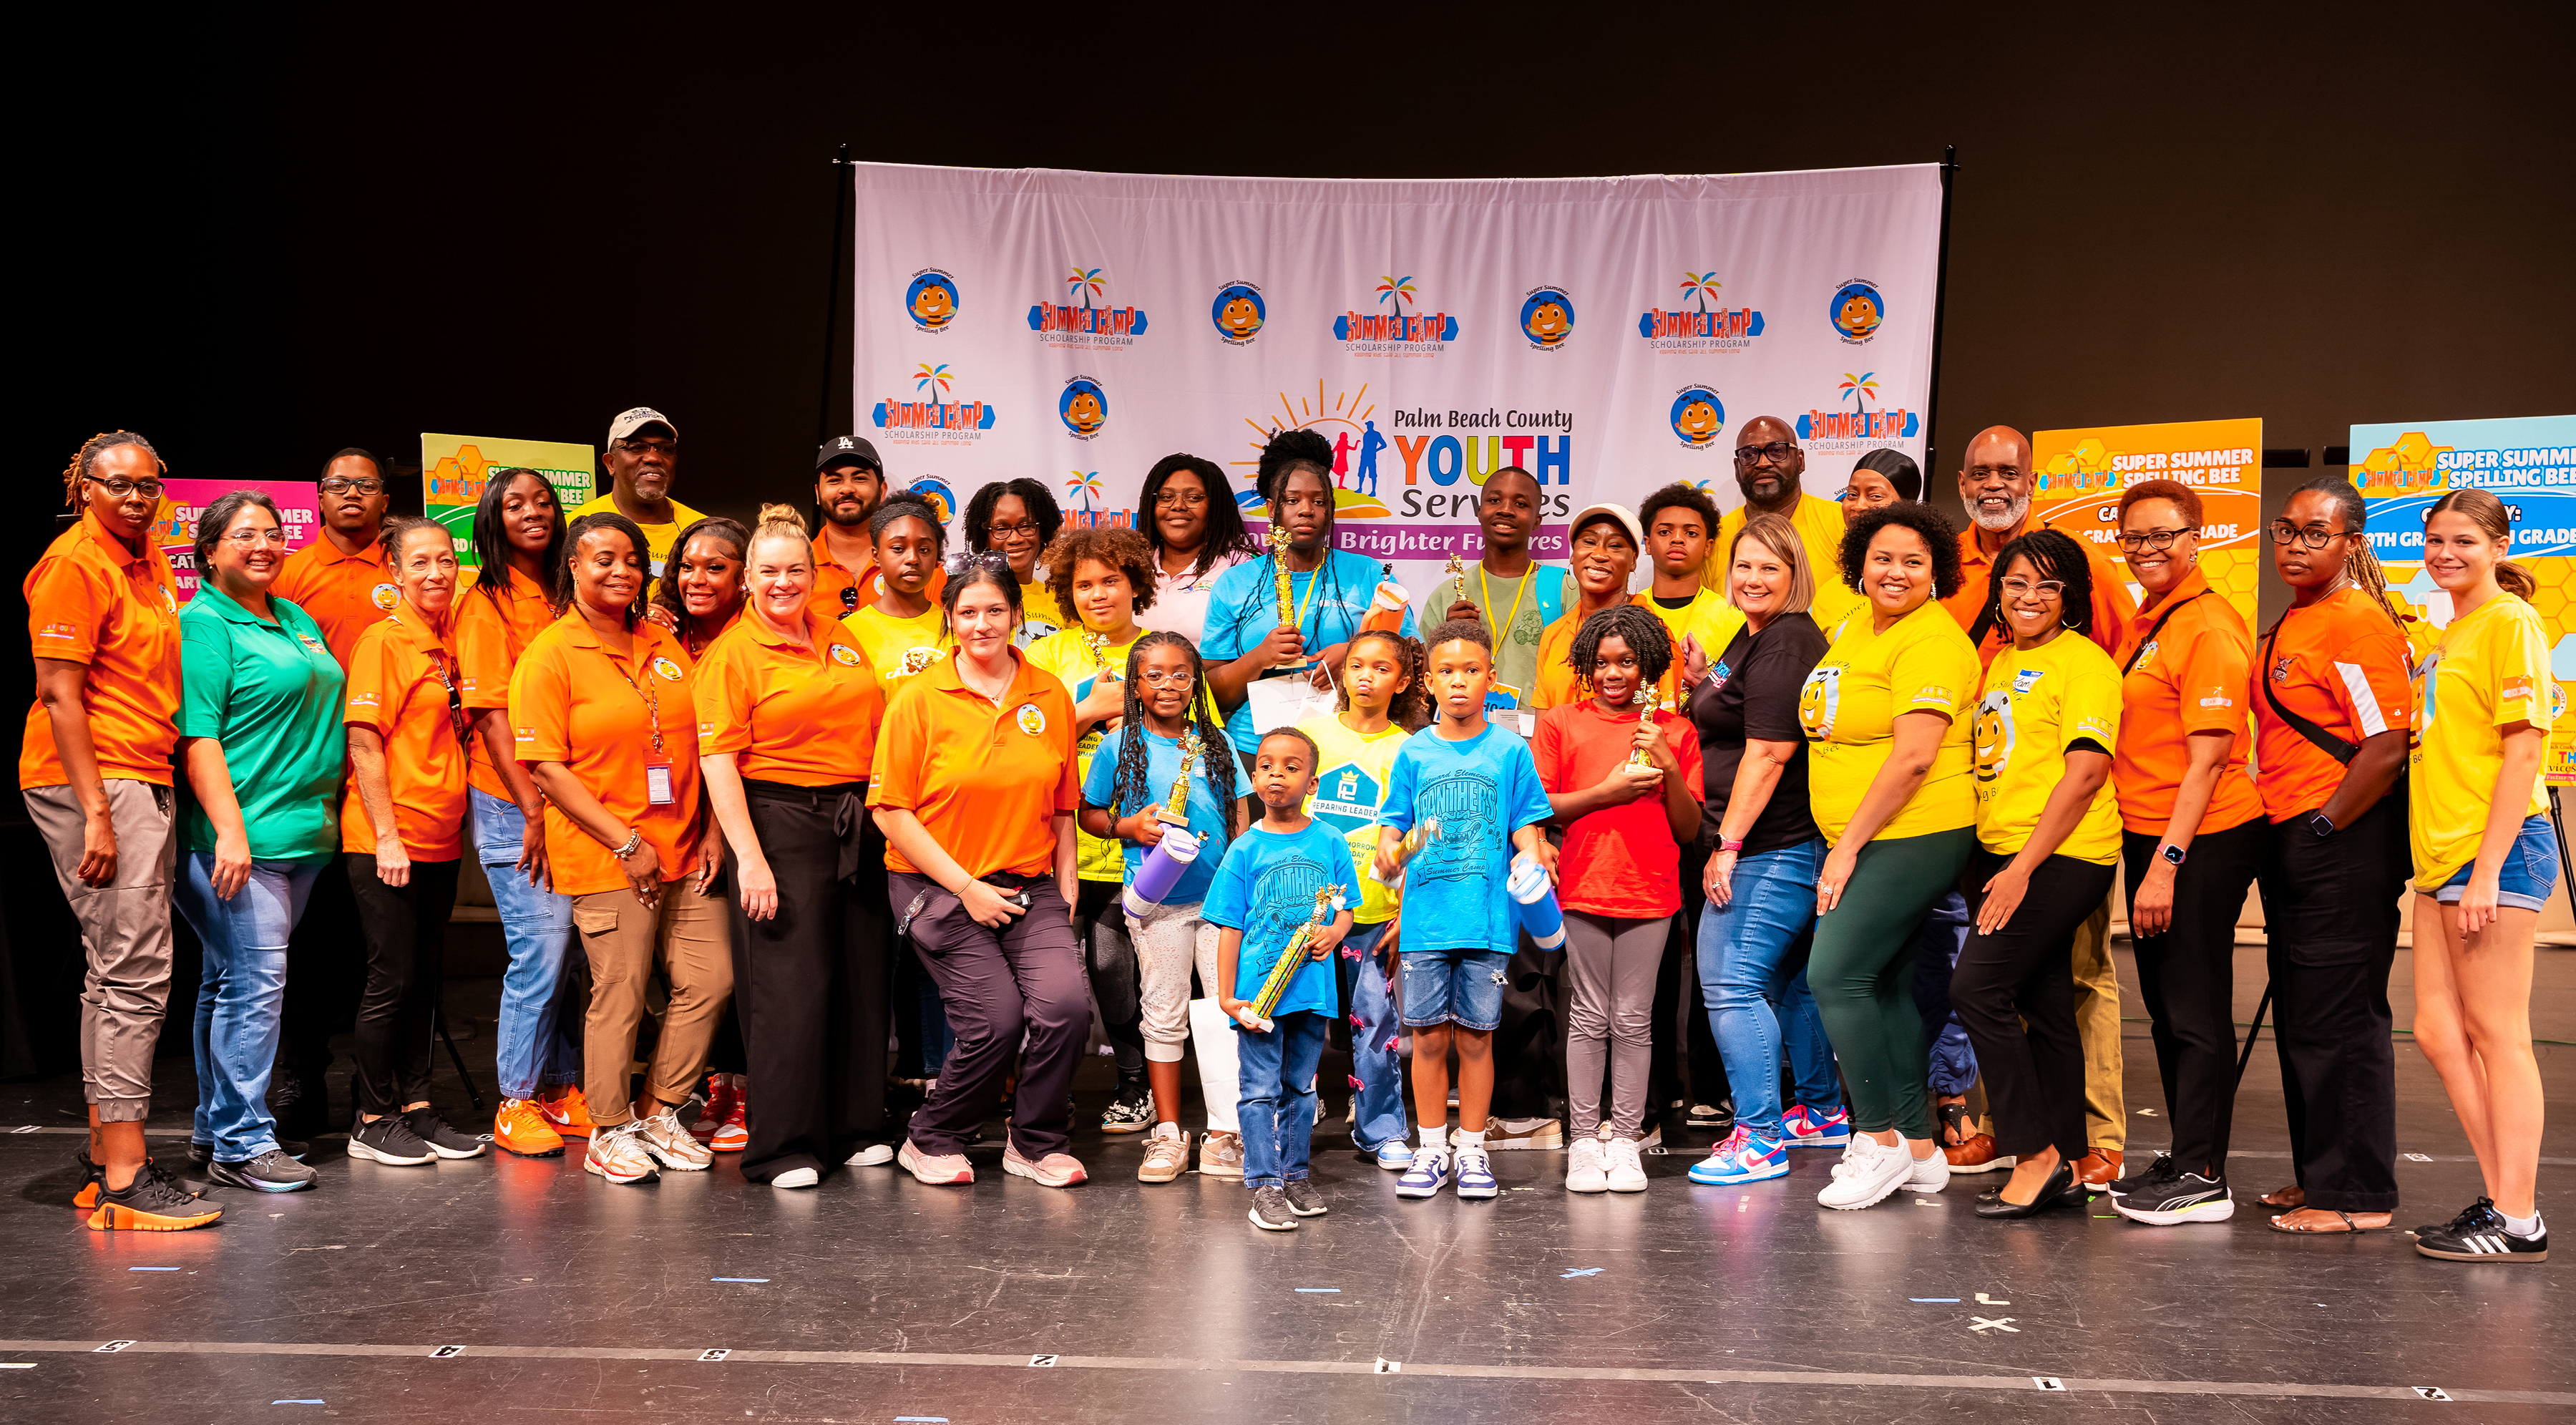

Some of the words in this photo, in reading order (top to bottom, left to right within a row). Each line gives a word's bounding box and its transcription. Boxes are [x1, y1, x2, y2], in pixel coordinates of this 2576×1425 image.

[912, 268, 928, 279] Super
[929, 267, 955, 280] Summer
[1218, 281, 1235, 291] Super
[1236, 280, 1262, 293] Summer
[1526, 286, 1543, 297] Super
[1544, 284, 1570, 297] Summer
[1835, 278, 1852, 290] Super
[1853, 277, 1879, 290] Summer
[1040, 301, 1091, 333] SUMMER
[1096, 303, 1136, 336] CAMP
[1650, 307, 1708, 340] SUMMER
[1712, 307, 1752, 339] CAMP
[914, 324, 938, 334] Spelling
[1346, 311, 1402, 342] SUMMER
[1406, 311, 1445, 343] CAMP
[1040, 334, 1091, 345] SCHOLARSHIP
[1093, 336, 1133, 346] PROGRAM
[1221, 336, 1245, 347] Spelling
[1246, 336, 1256, 345] Bee
[1529, 342, 1553, 353] Spelling
[1554, 341, 1565, 350] Bee
[1650, 340, 1707, 349] SCHOLARSHIP
[1709, 339, 1750, 349] PROGRAM
[1840, 335, 1863, 346] Spelling
[1864, 335, 1875, 344] Bee
[1345, 343, 1401, 352] SCHOLARSHIP
[1404, 344, 1444, 352] PROGRAM
[1065, 375, 1079, 386] Super
[1080, 374, 1103, 387] Summer
[1676, 384, 1692, 395] Super
[1694, 383, 1719, 395] Summer
[884, 397, 940, 429] SUMMER
[944, 399, 984, 431] CAMP
[1394, 408, 1442, 429] Palm
[1448, 407, 1501, 429] Beach
[1506, 409, 1573, 432] County
[1809, 409, 1865, 441] SUMMER
[1869, 407, 1907, 439] CAMP
[884, 430, 939, 439] SCHOLARSHIP
[941, 431, 981, 440] PROGRAM
[1068, 430, 1089, 442] Spelling
[838, 437, 854, 449] LA
[1679, 440, 1703, 452] Spelling
[1808, 441, 1865, 450] SCHOLARSHIP
[1867, 440, 1904, 449] PROGRAM
[1393, 434, 1571, 487] YOUTH
[2112, 454, 2167, 472] SUPER
[2170, 448, 2253, 468] SUMMER
[2437, 451, 2499, 470] SUPER
[909, 474, 925, 485] Super
[926, 473, 951, 485] Summer
[2209, 467, 2241, 483] BEE
[2449, 468, 2541, 487] SPELLING
[560, 488, 583, 504] BEE
[283, 525, 303, 540] EE
[2200, 523, 2238, 539] RADE
[452, 538, 468, 553] RD
[1341, 530, 1453, 555] Brighter
[1463, 532, 1563, 551] Fures
[1420, 771, 1451, 789] estward
[1454, 769, 1499, 787] Elementary
[1419, 779, 1498, 823] PANTHERS
[1312, 802, 1347, 812] REPARING
[1350, 807, 1378, 817] LEADER
[1291, 855, 1329, 874] Elementary
[1426, 867, 1460, 876] Summer
[1462, 863, 1486, 874] Camp
